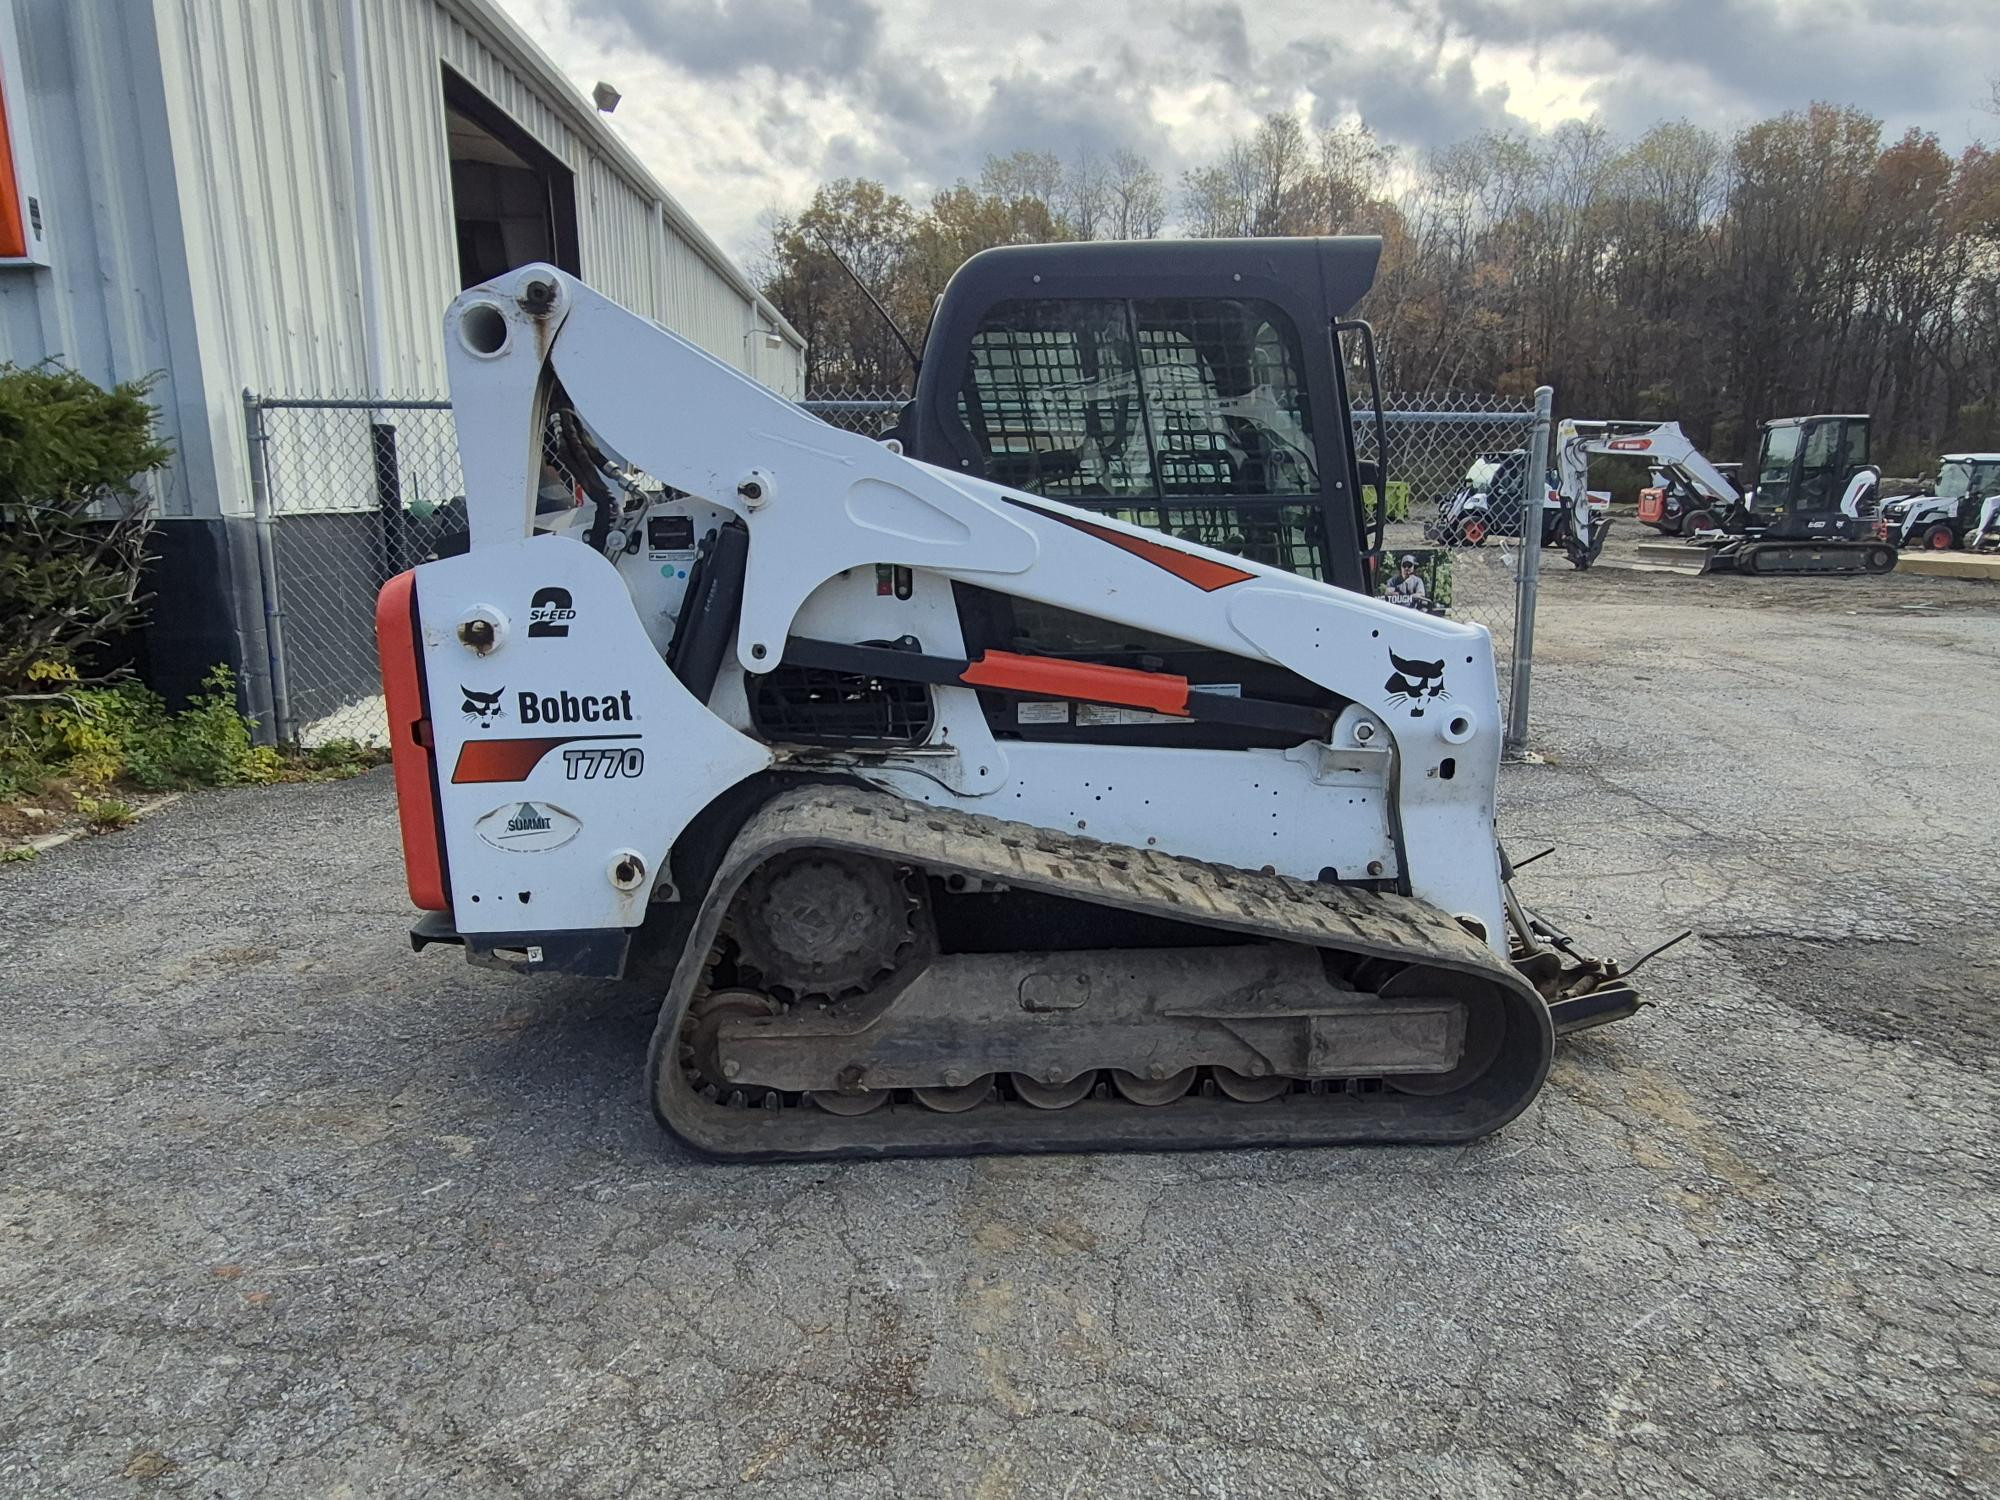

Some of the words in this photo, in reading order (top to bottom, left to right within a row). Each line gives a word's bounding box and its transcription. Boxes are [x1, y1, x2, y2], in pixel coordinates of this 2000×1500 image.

[1388, 594, 1413, 604] TOUGH
[528, 587, 573, 637] 2
[530, 610, 576, 620] SPEED
[518, 690, 633, 723] Bobcat
[563, 748, 644, 780] T770
[508, 818, 551, 831] SUMMIT
